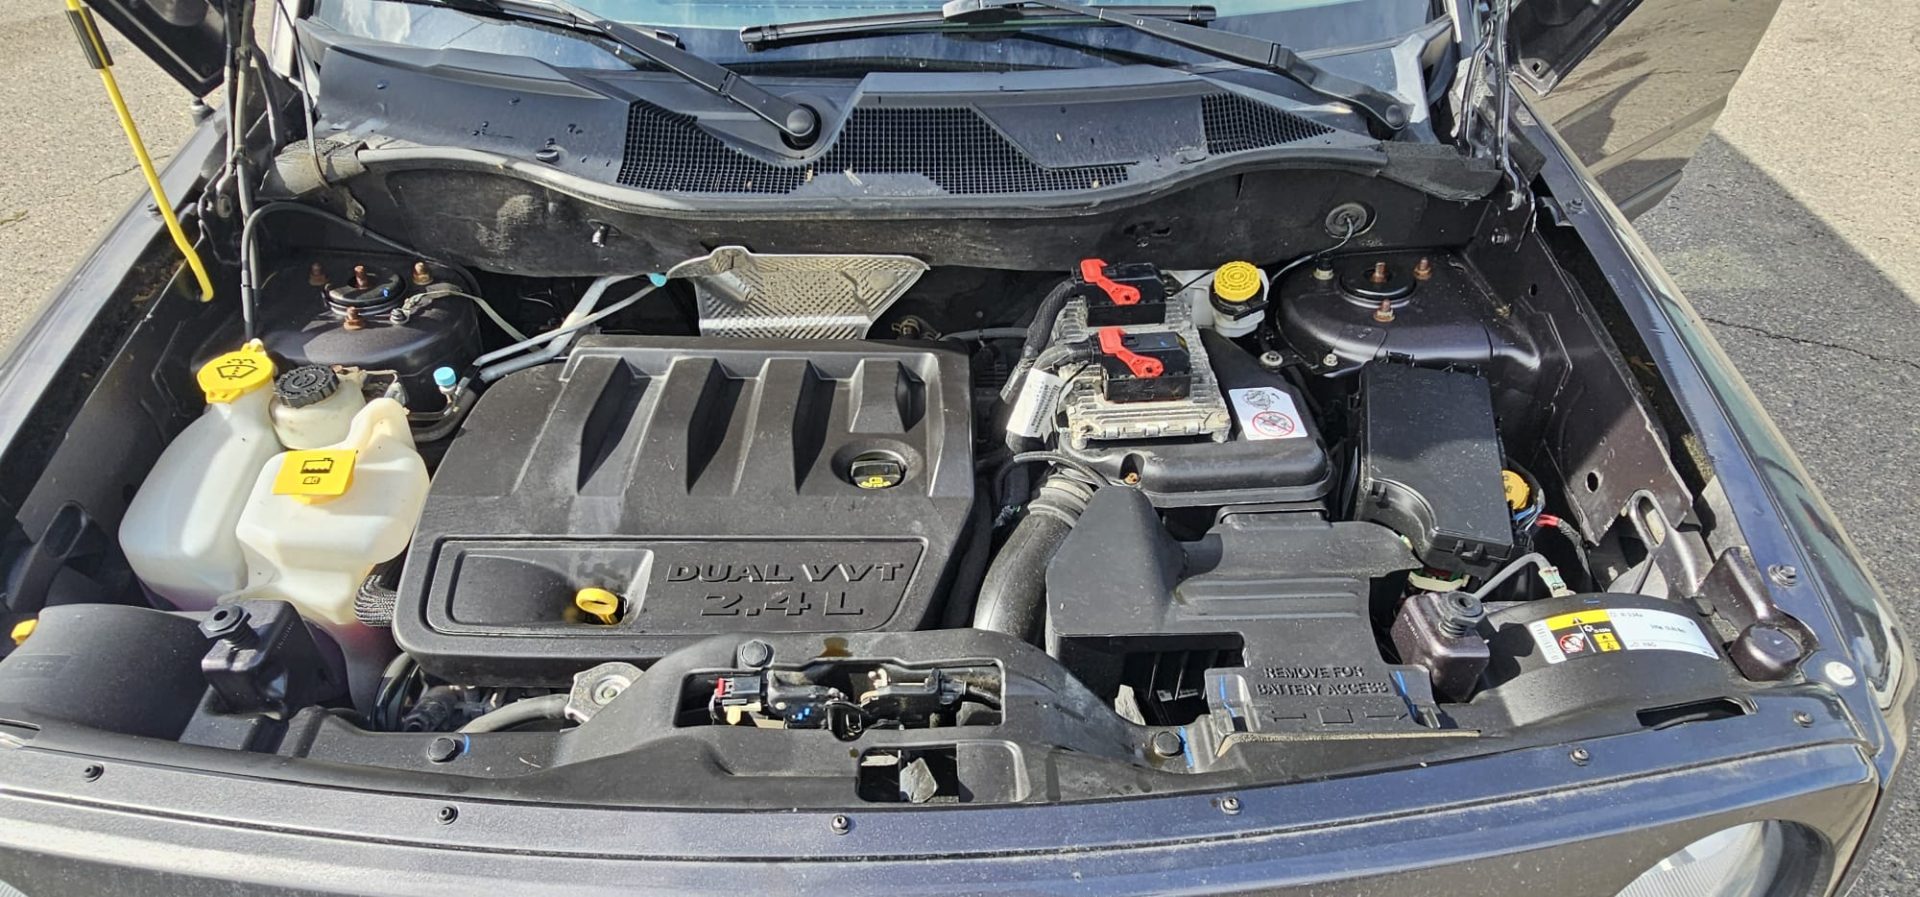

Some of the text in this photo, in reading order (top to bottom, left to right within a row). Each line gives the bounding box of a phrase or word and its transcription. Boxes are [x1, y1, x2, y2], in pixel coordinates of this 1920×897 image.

[667, 562, 904, 584] DUAL VVT
[1264, 665, 1365, 679] REMOVE FOR
[1257, 682, 1389, 696] BATTERY ACCESS
